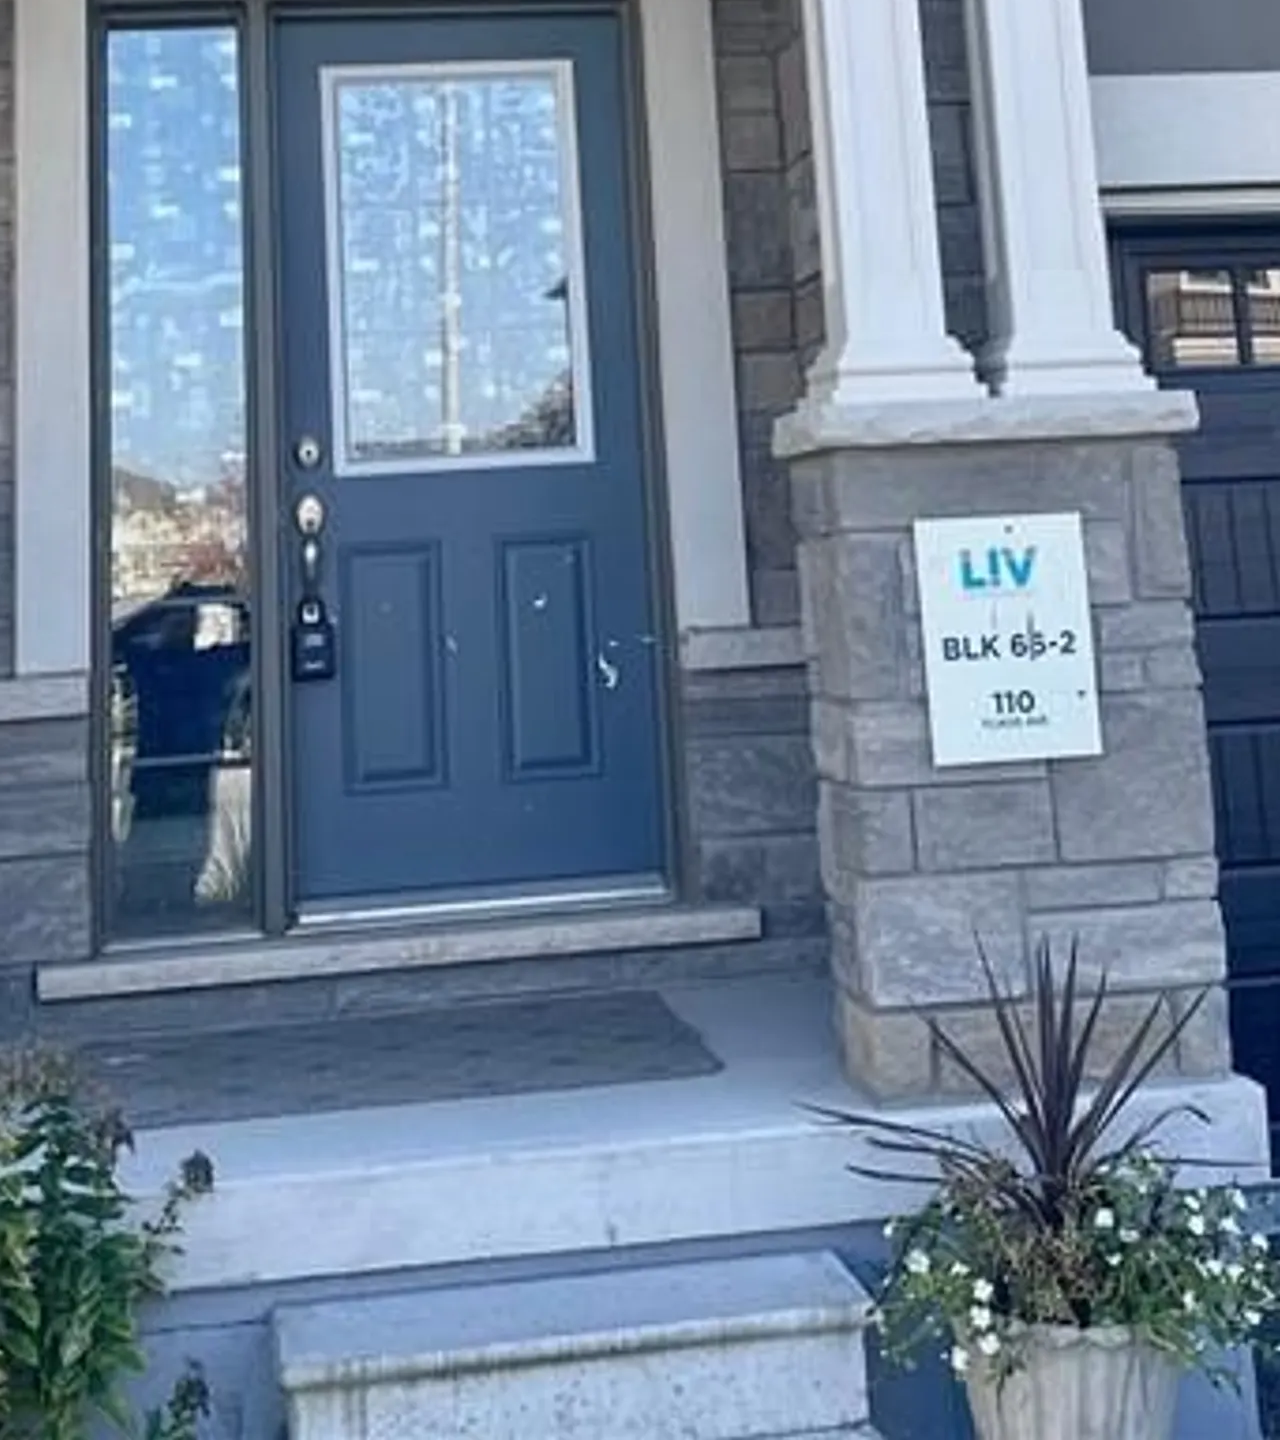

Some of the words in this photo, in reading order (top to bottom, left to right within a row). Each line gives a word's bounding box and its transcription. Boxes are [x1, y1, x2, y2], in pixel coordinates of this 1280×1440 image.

[959, 546, 1035, 589] LIV
[942, 634, 1001, 662] BLK
[992, 689, 1036, 714] 110
